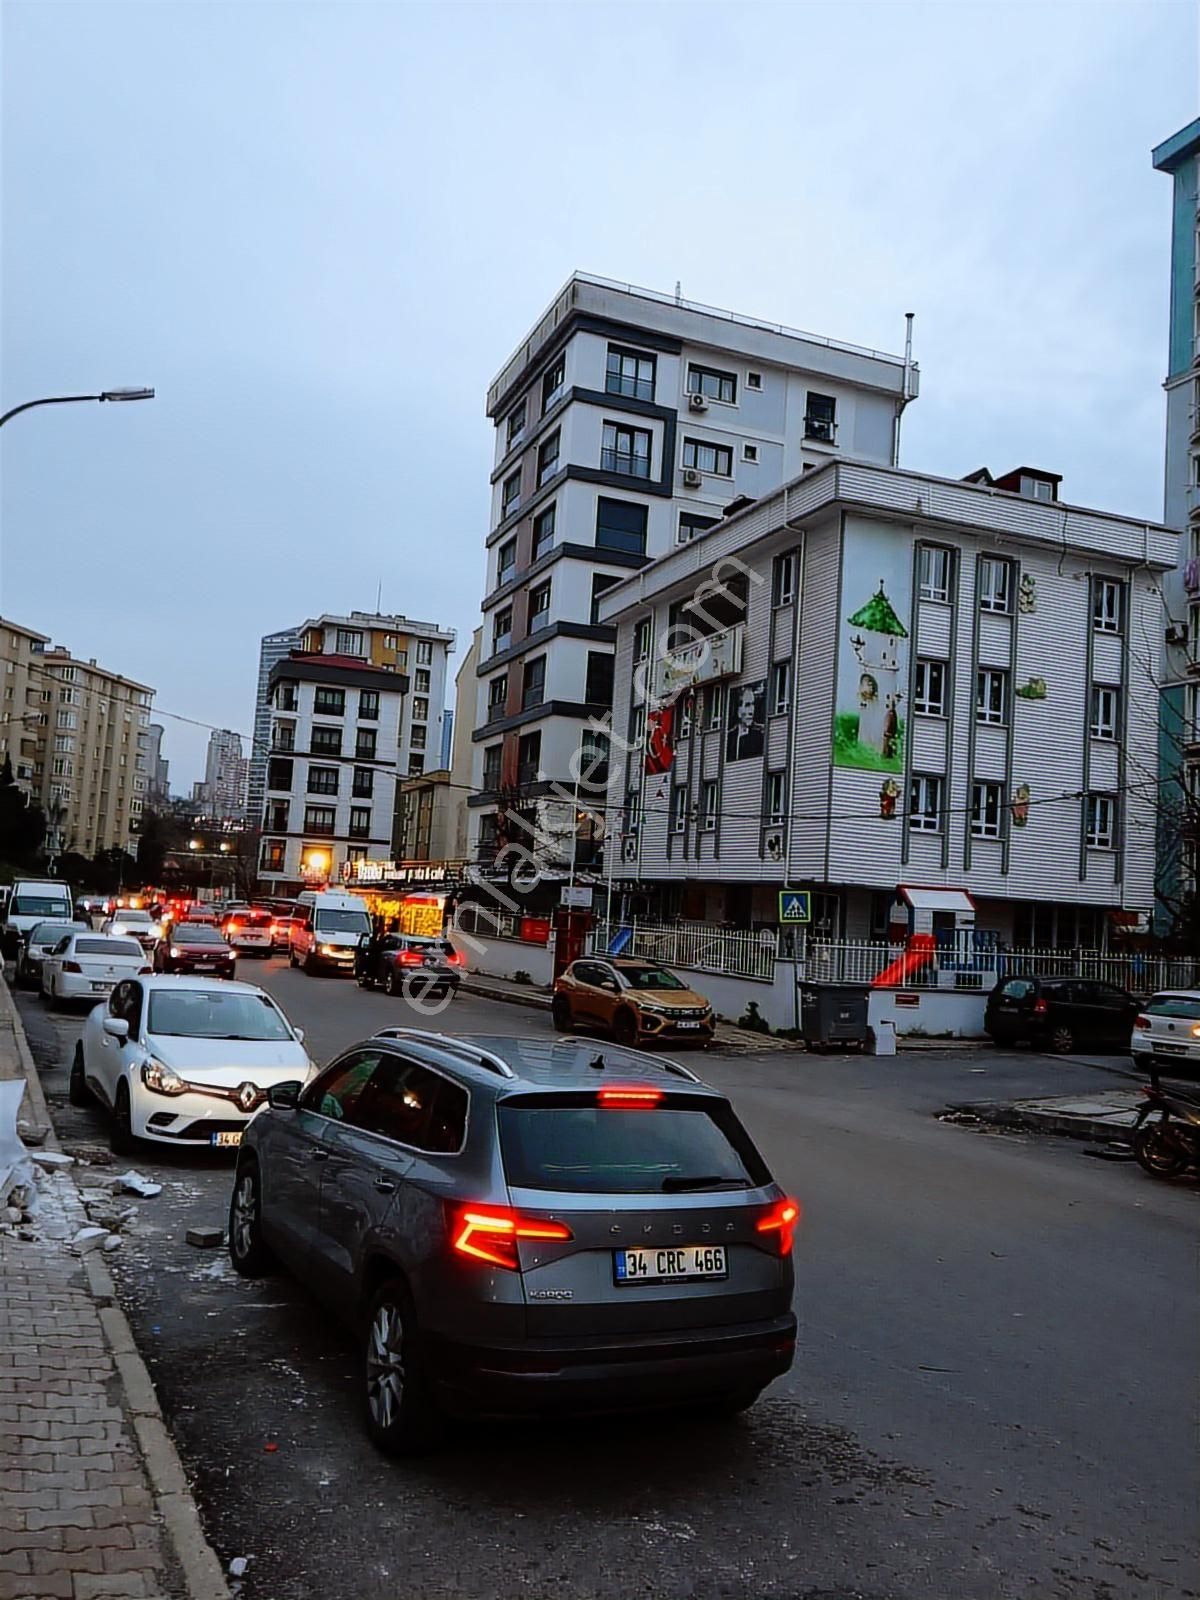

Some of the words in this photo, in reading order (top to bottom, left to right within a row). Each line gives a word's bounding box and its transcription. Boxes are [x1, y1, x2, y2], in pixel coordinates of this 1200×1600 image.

[218, 1132, 230, 1144] 34
[627, 1253, 647, 1275] 34
[656, 1251, 686, 1274] CRC
[695, 1249, 723, 1272] 466
